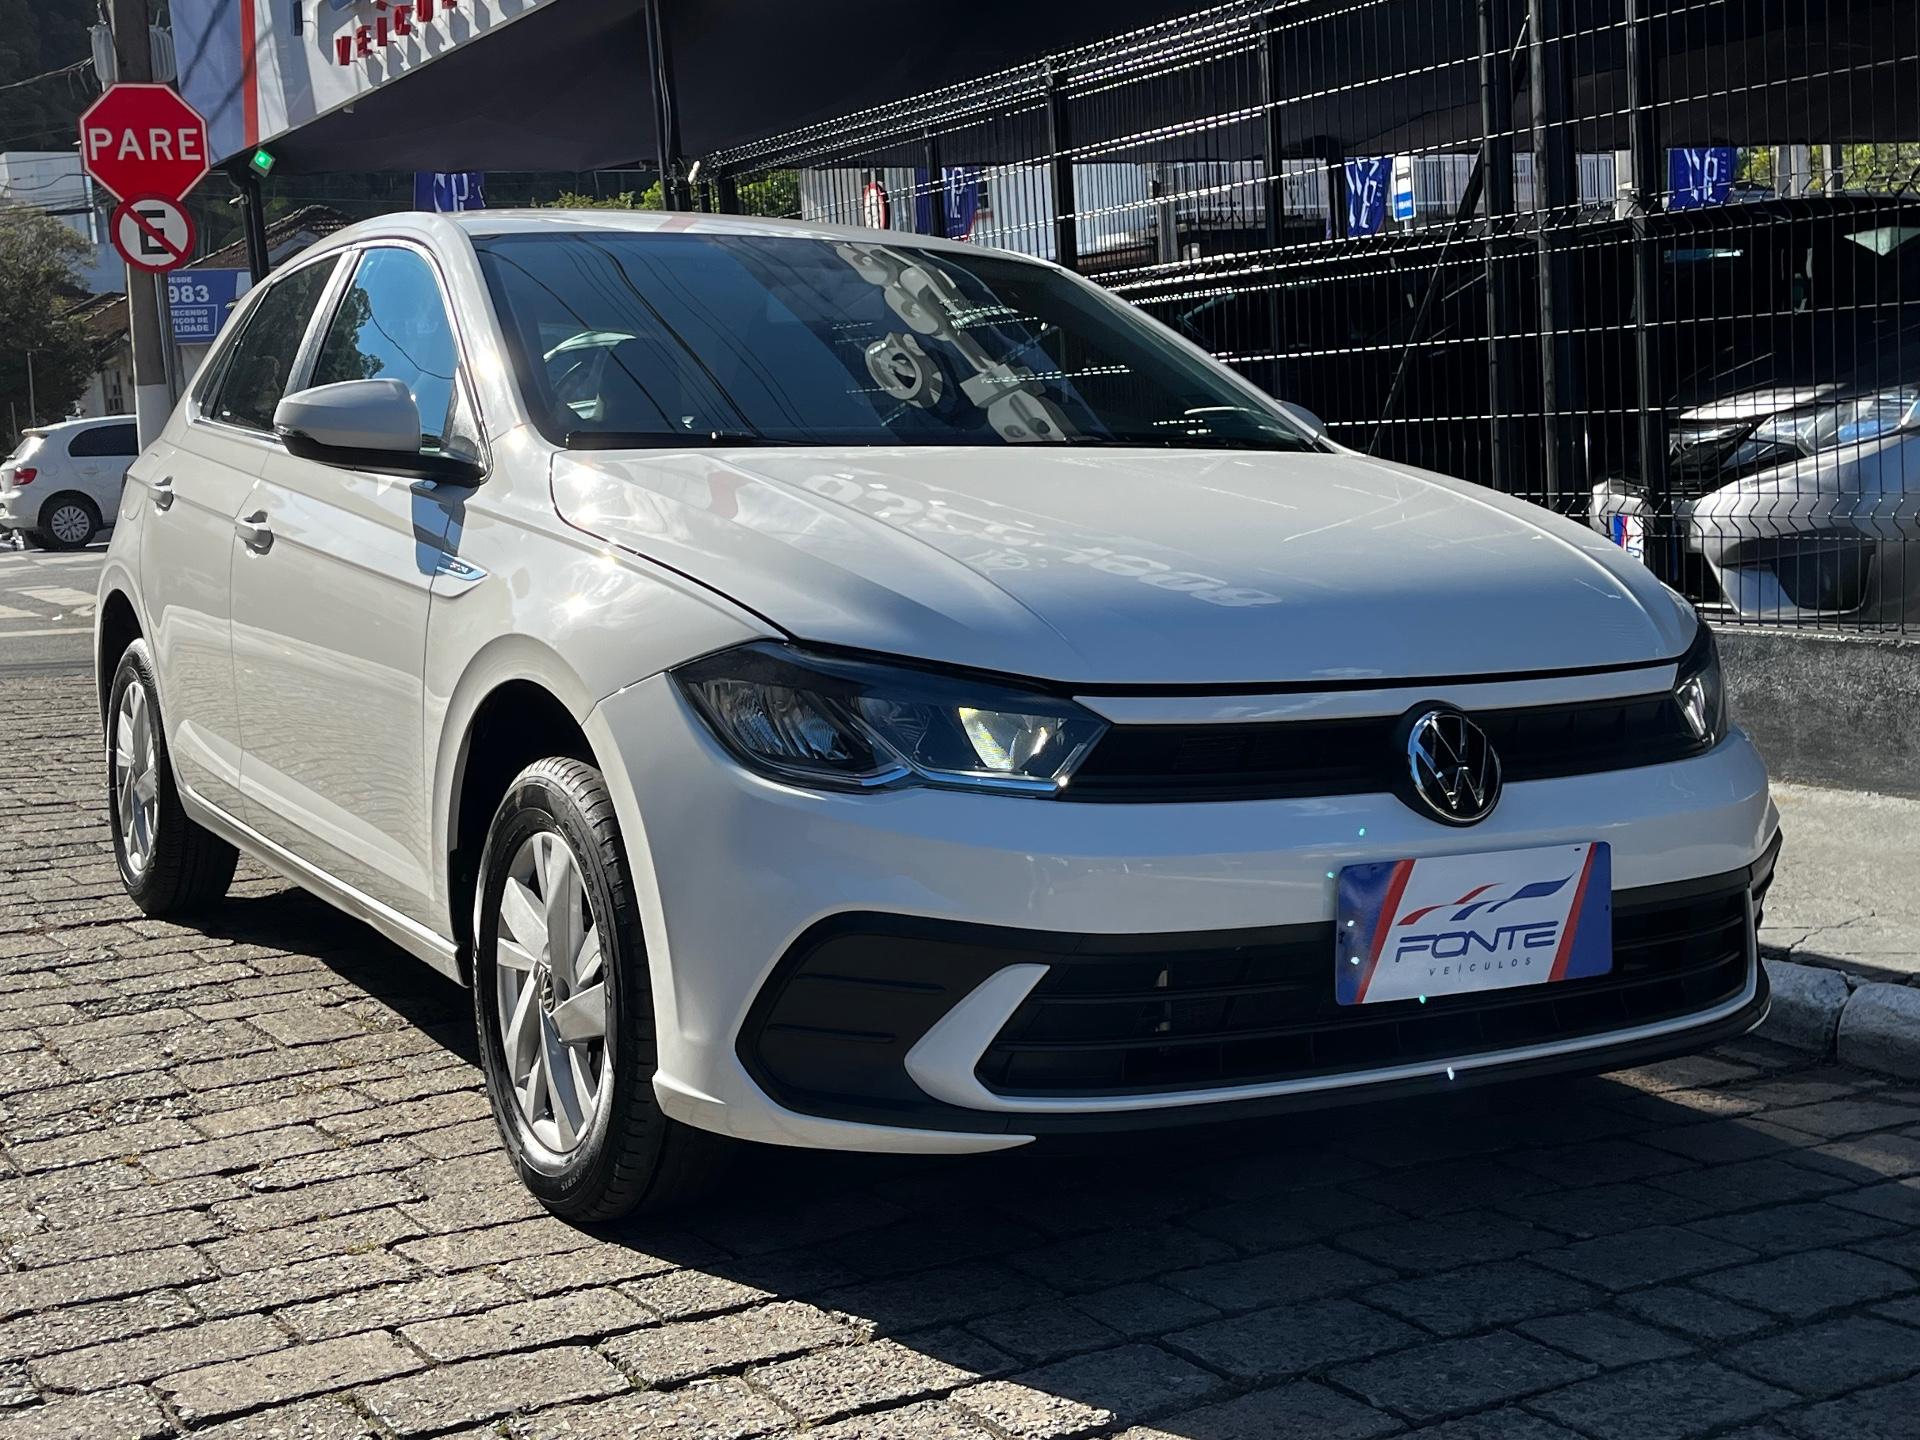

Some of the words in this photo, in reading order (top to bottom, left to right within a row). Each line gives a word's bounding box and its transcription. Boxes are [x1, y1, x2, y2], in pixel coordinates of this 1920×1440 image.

[88, 127, 202, 161] PARE
[137, 209, 170, 255] E
[1395, 920, 1559, 963] FONTE
